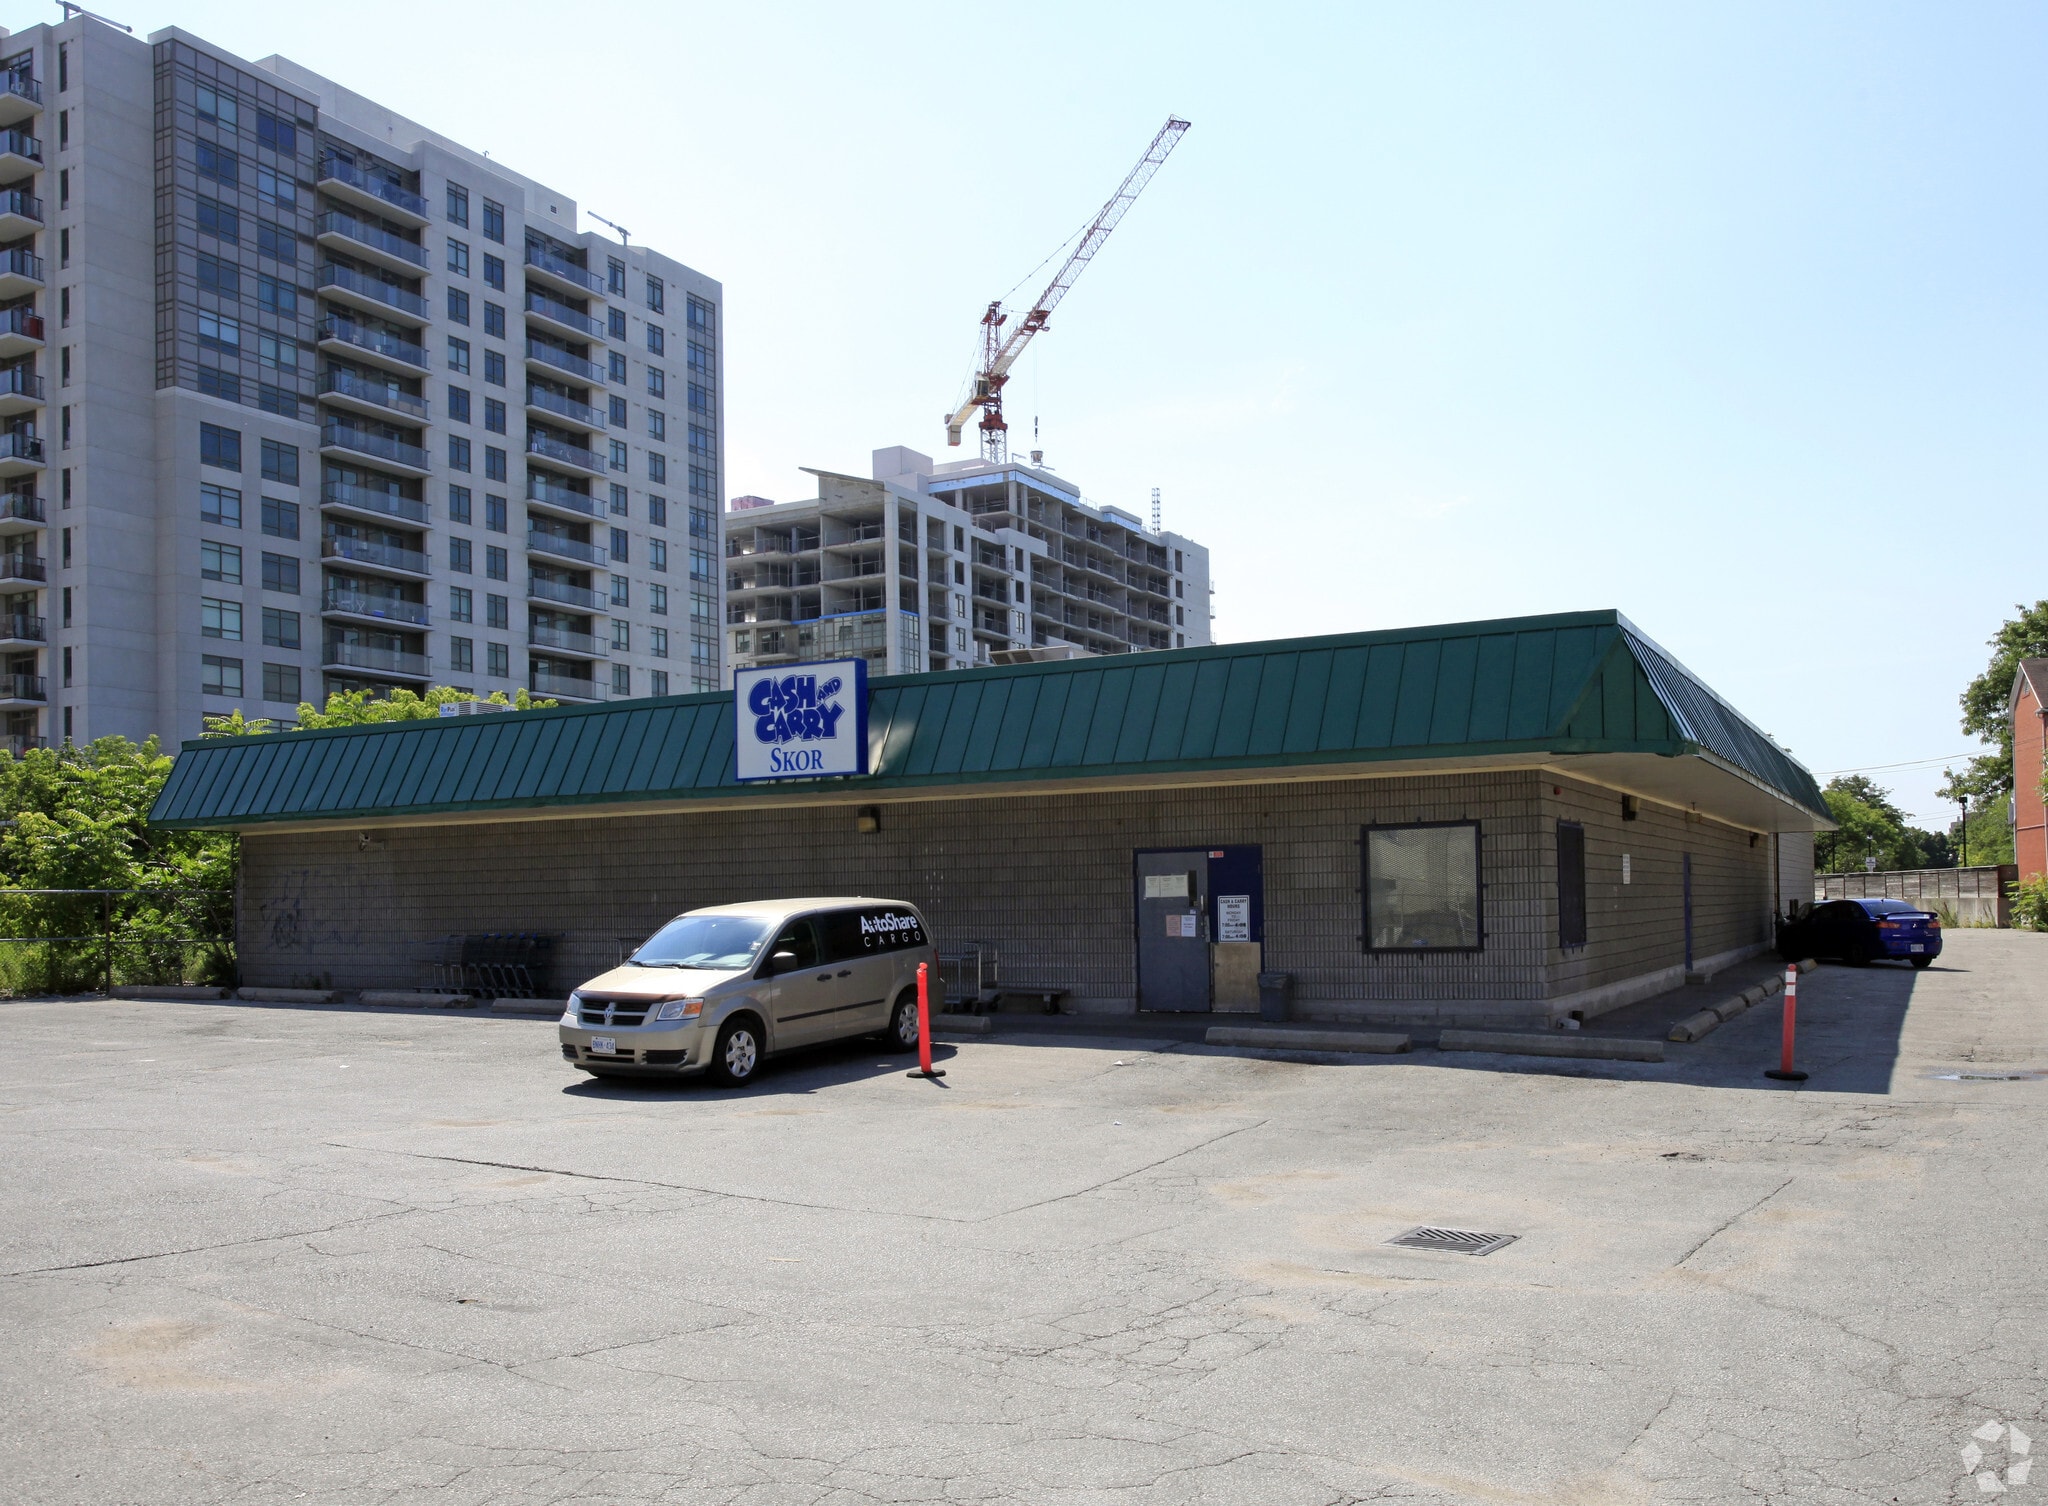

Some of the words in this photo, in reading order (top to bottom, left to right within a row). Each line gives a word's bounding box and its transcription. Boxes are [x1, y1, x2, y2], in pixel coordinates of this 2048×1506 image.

[748, 675, 816, 716] CASH
[817, 677, 842, 703] AND
[754, 702, 845, 744] CARRY
[770, 747, 824, 772] SKOR
[861, 913, 917, 934] AutoShare
[864, 931, 920, 947] CARGO
